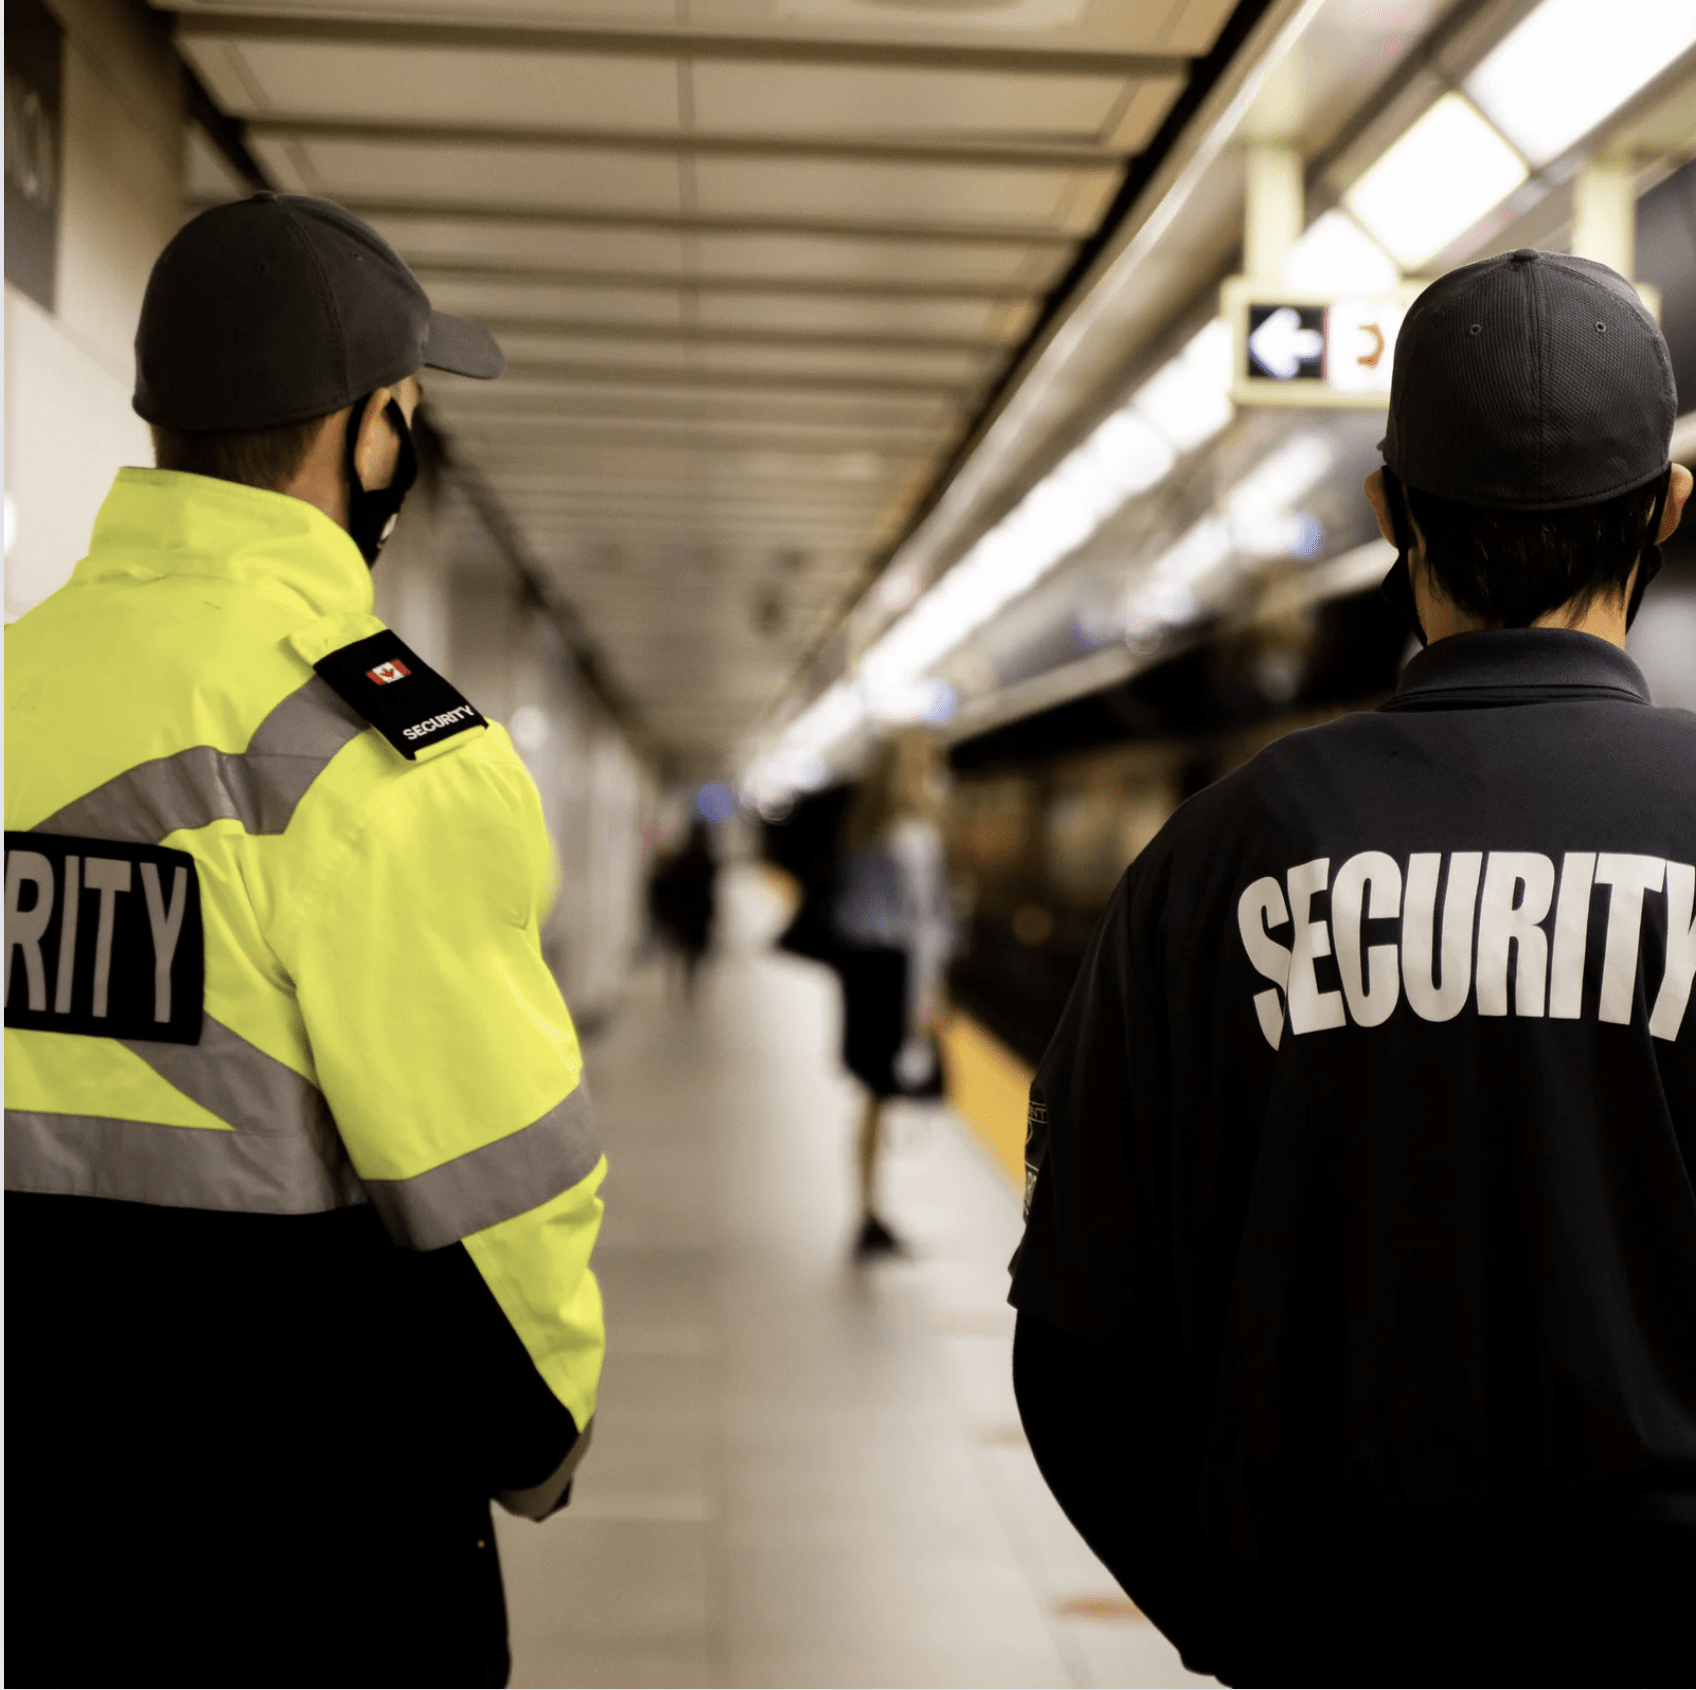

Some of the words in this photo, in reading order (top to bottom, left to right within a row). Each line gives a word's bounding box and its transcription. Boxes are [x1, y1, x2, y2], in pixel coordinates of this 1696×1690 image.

[403, 705, 475, 740] SECURITY
[4, 849, 188, 1023] RITY
[1237, 850, 1696, 1051] SECURITY
